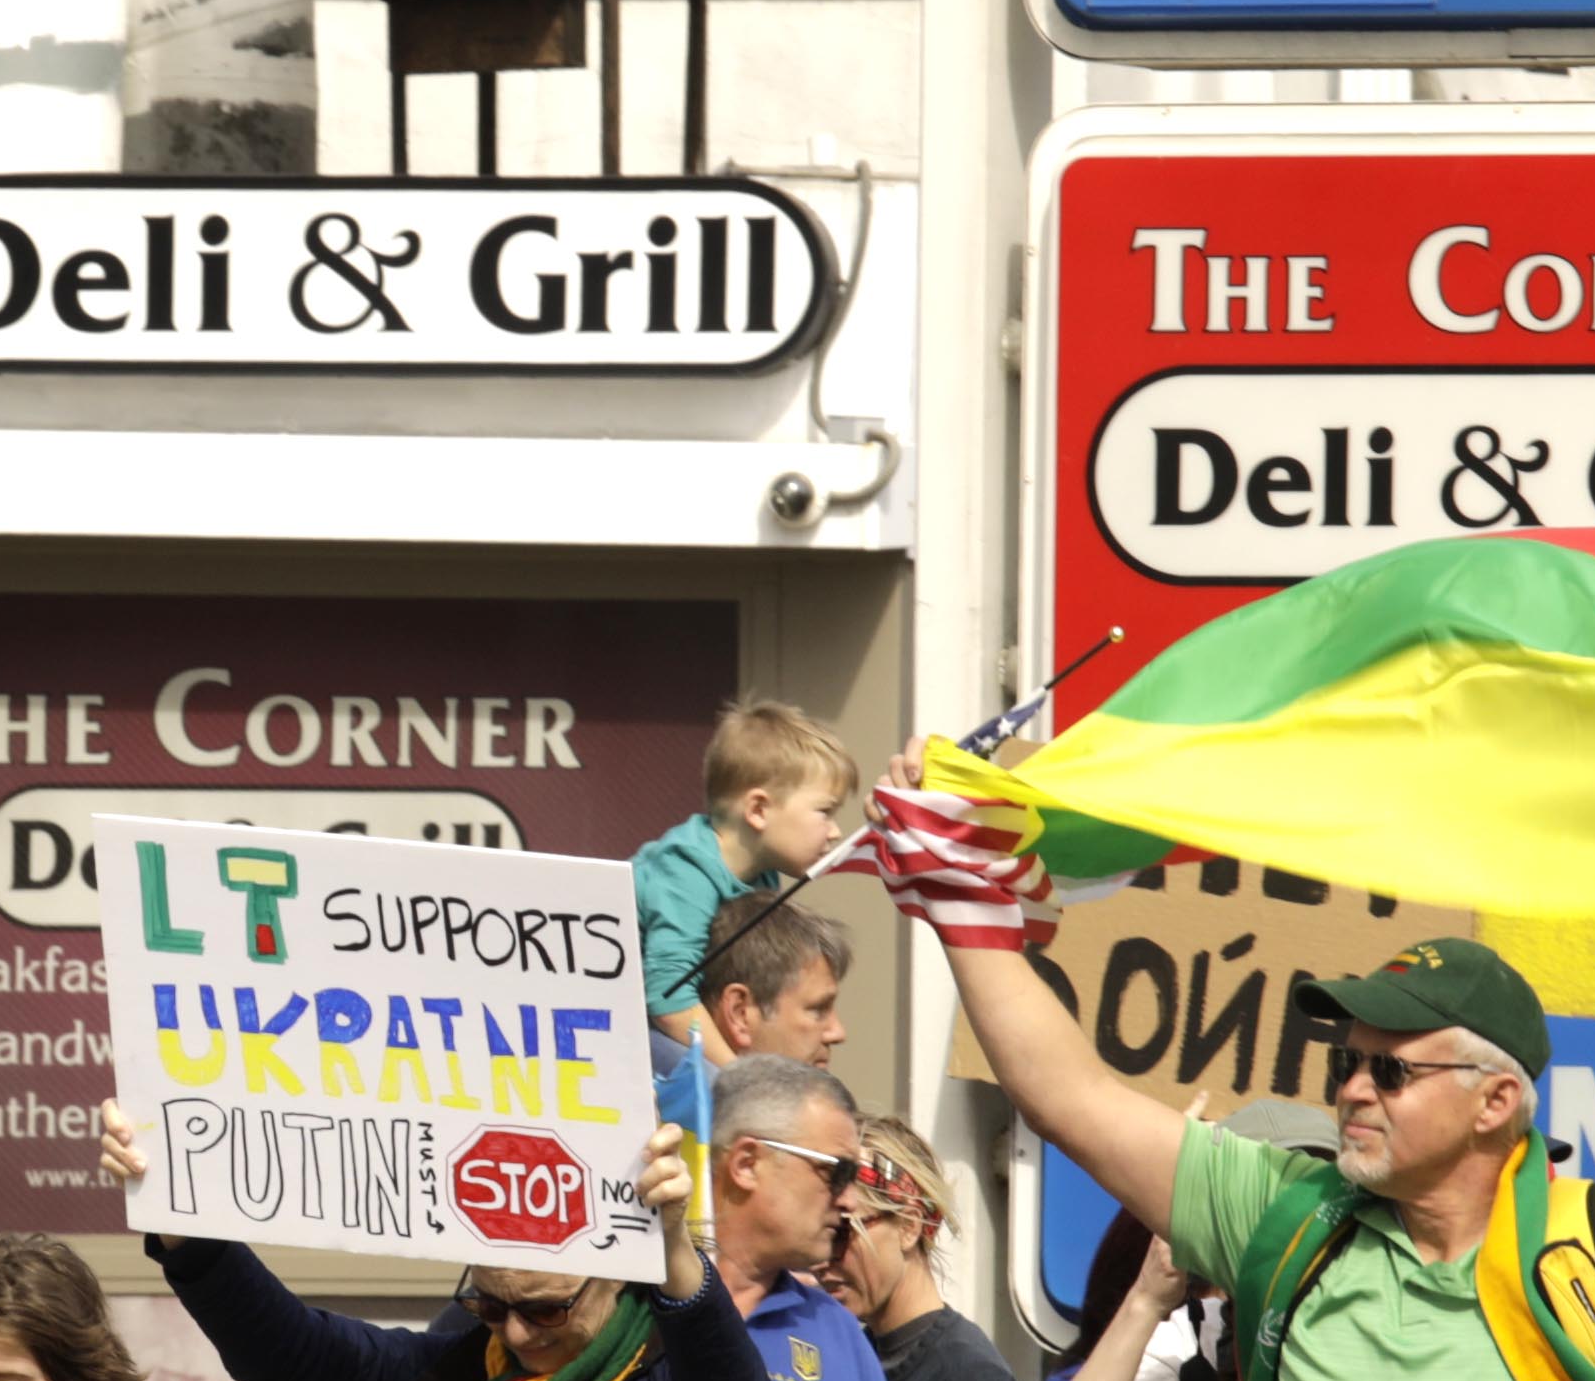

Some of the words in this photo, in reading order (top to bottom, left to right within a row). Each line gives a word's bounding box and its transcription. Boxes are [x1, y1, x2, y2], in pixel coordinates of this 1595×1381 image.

[287, 210, 422, 337] &
[468, 212, 780, 337] Grill
[1131, 225, 1337, 336] THE
[1148, 423, 1399, 531] Deli
[1439, 423, 1552, 531] &
[151, 666, 585, 770] CORNER
[134, 840, 299, 966] LT
[322, 887, 626, 980] SUPPORTS
[151, 982, 621, 1125] UKRAINE
[1024, 932, 1361, 1108] ОЙН
[161, 1096, 414, 1239] PUTIN
[416, 1121, 438, 1206] MUST
[459, 1158, 584, 1225] STOP
